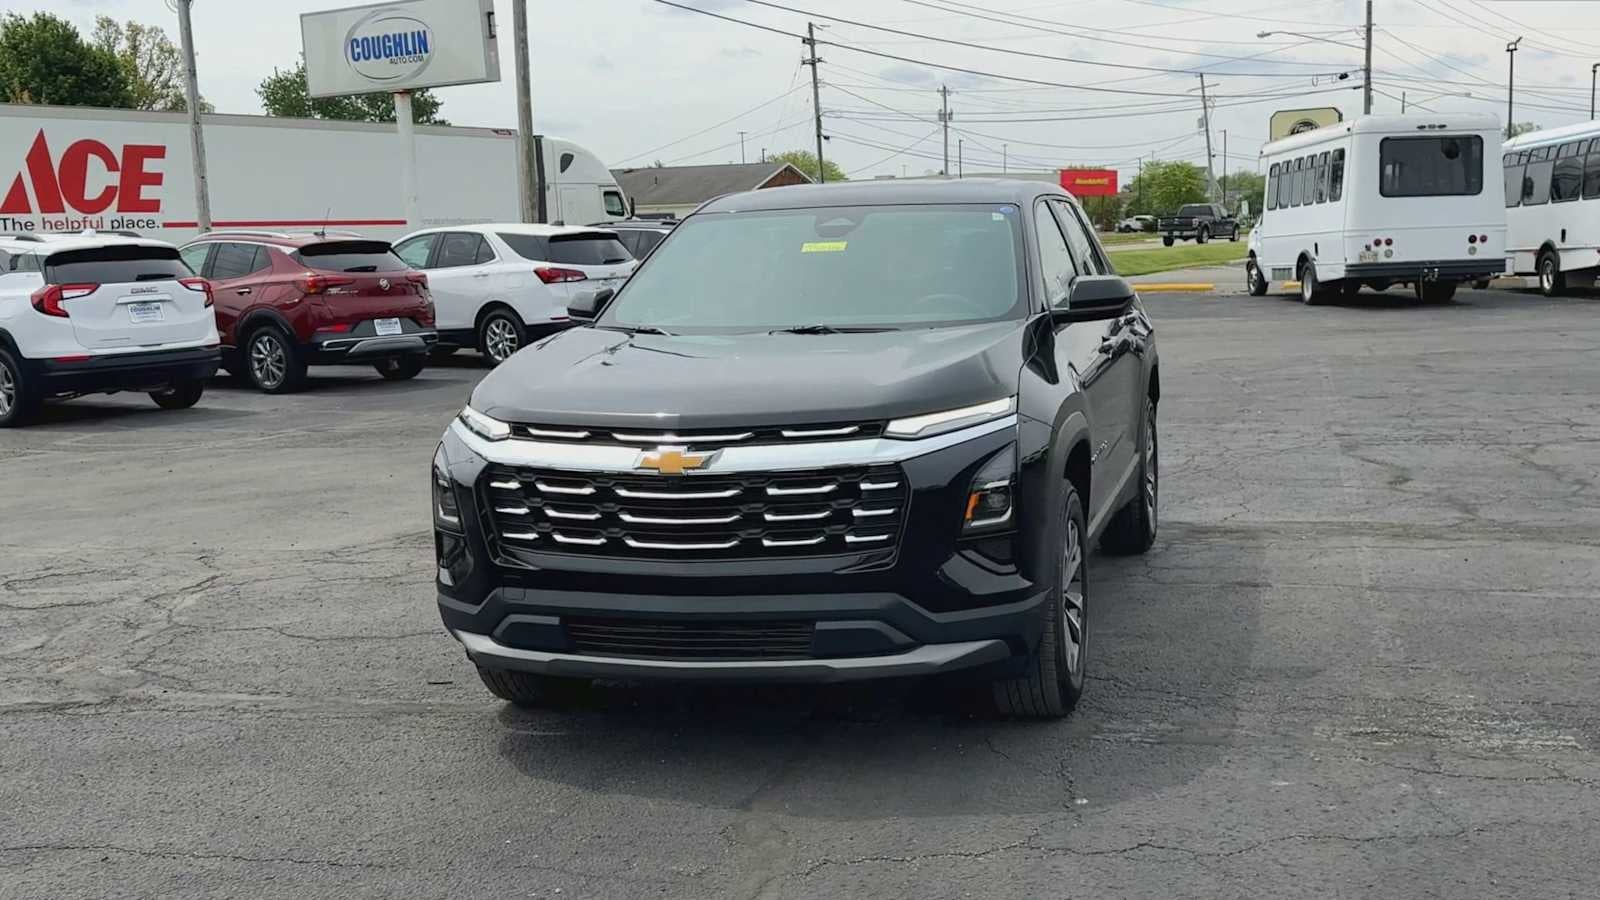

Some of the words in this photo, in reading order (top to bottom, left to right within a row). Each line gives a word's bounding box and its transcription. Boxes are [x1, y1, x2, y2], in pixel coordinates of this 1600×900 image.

[351, 30, 429, 62] COUGHLIN
[0, 128, 167, 214] ACE
[0, 218, 35, 231] The
[42, 216, 104, 231] helpful
[111, 216, 160, 231] place.
